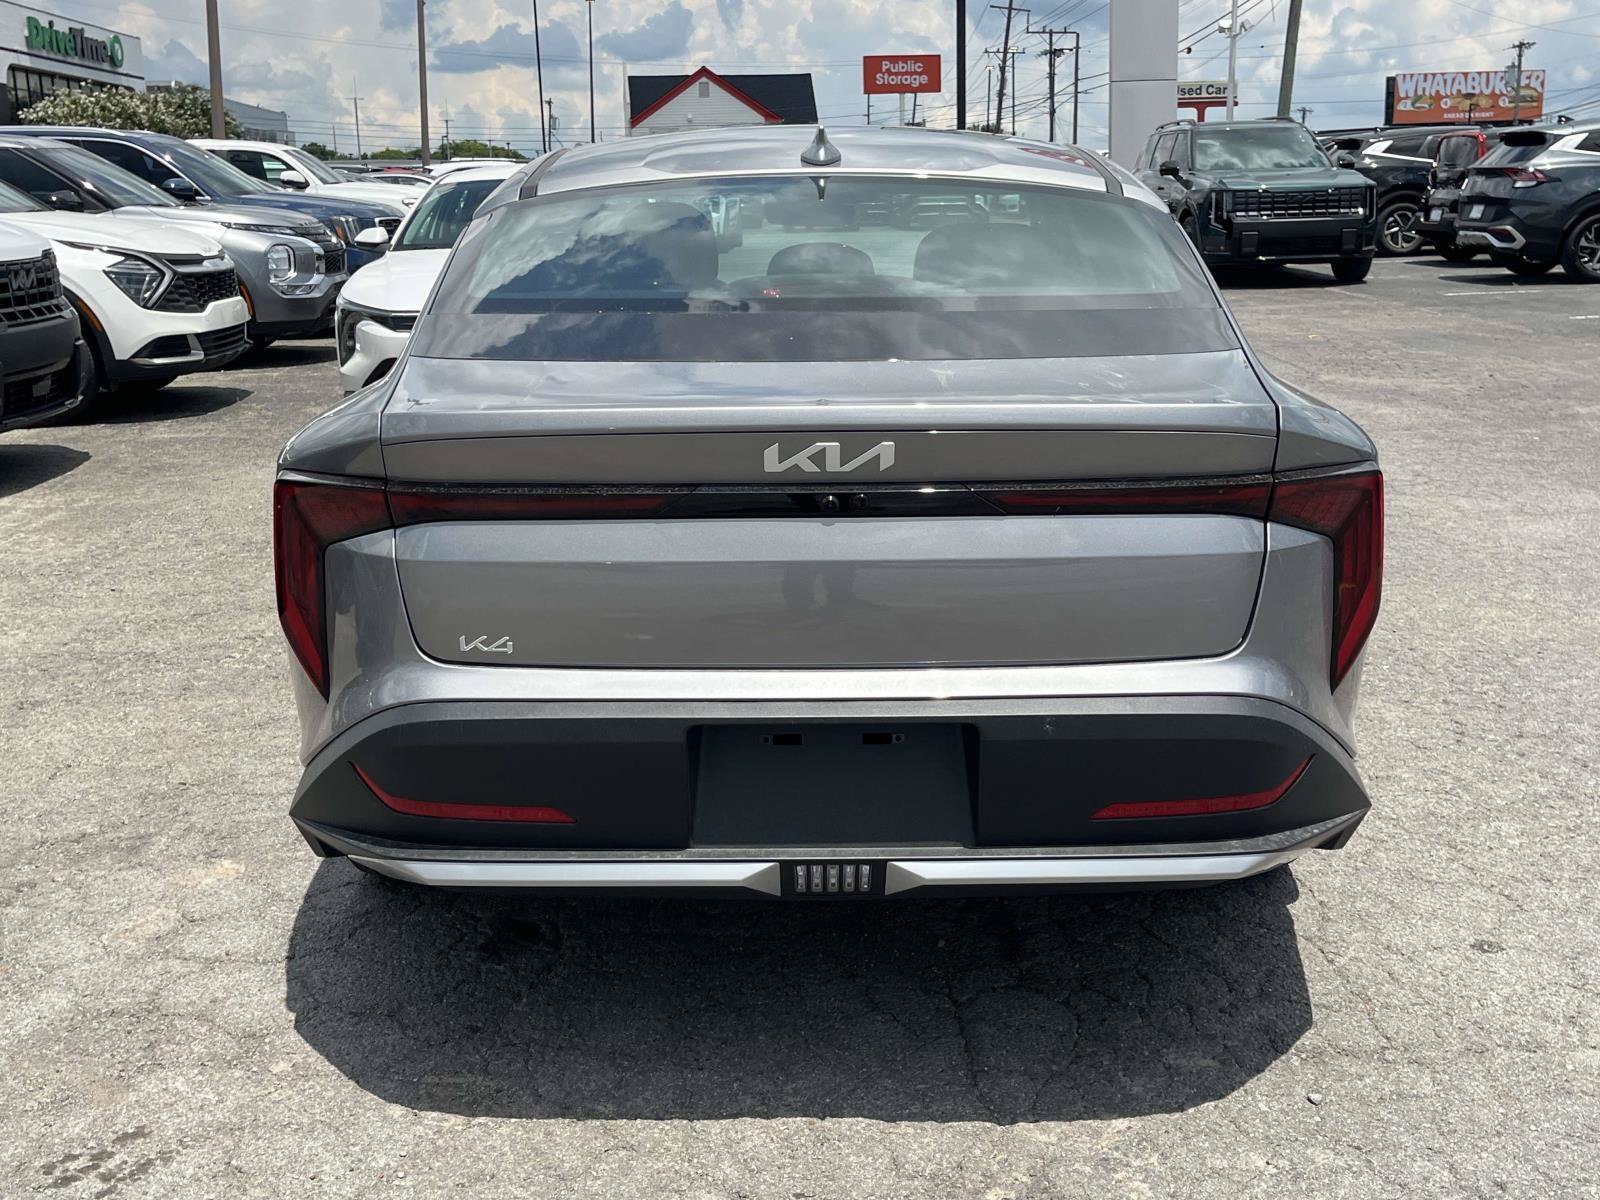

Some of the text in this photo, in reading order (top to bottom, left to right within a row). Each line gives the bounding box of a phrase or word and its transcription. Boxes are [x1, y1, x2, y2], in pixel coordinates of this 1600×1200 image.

[26, 16, 109, 63] DriveTime
[882, 61, 924, 72] Public
[876, 73, 928, 87] Storage
[1397, 71, 1543, 97] WHATABURER
[1206, 84, 1228, 95] Car
[763, 441, 896, 473] KIA
[459, 635, 513, 653] K4
